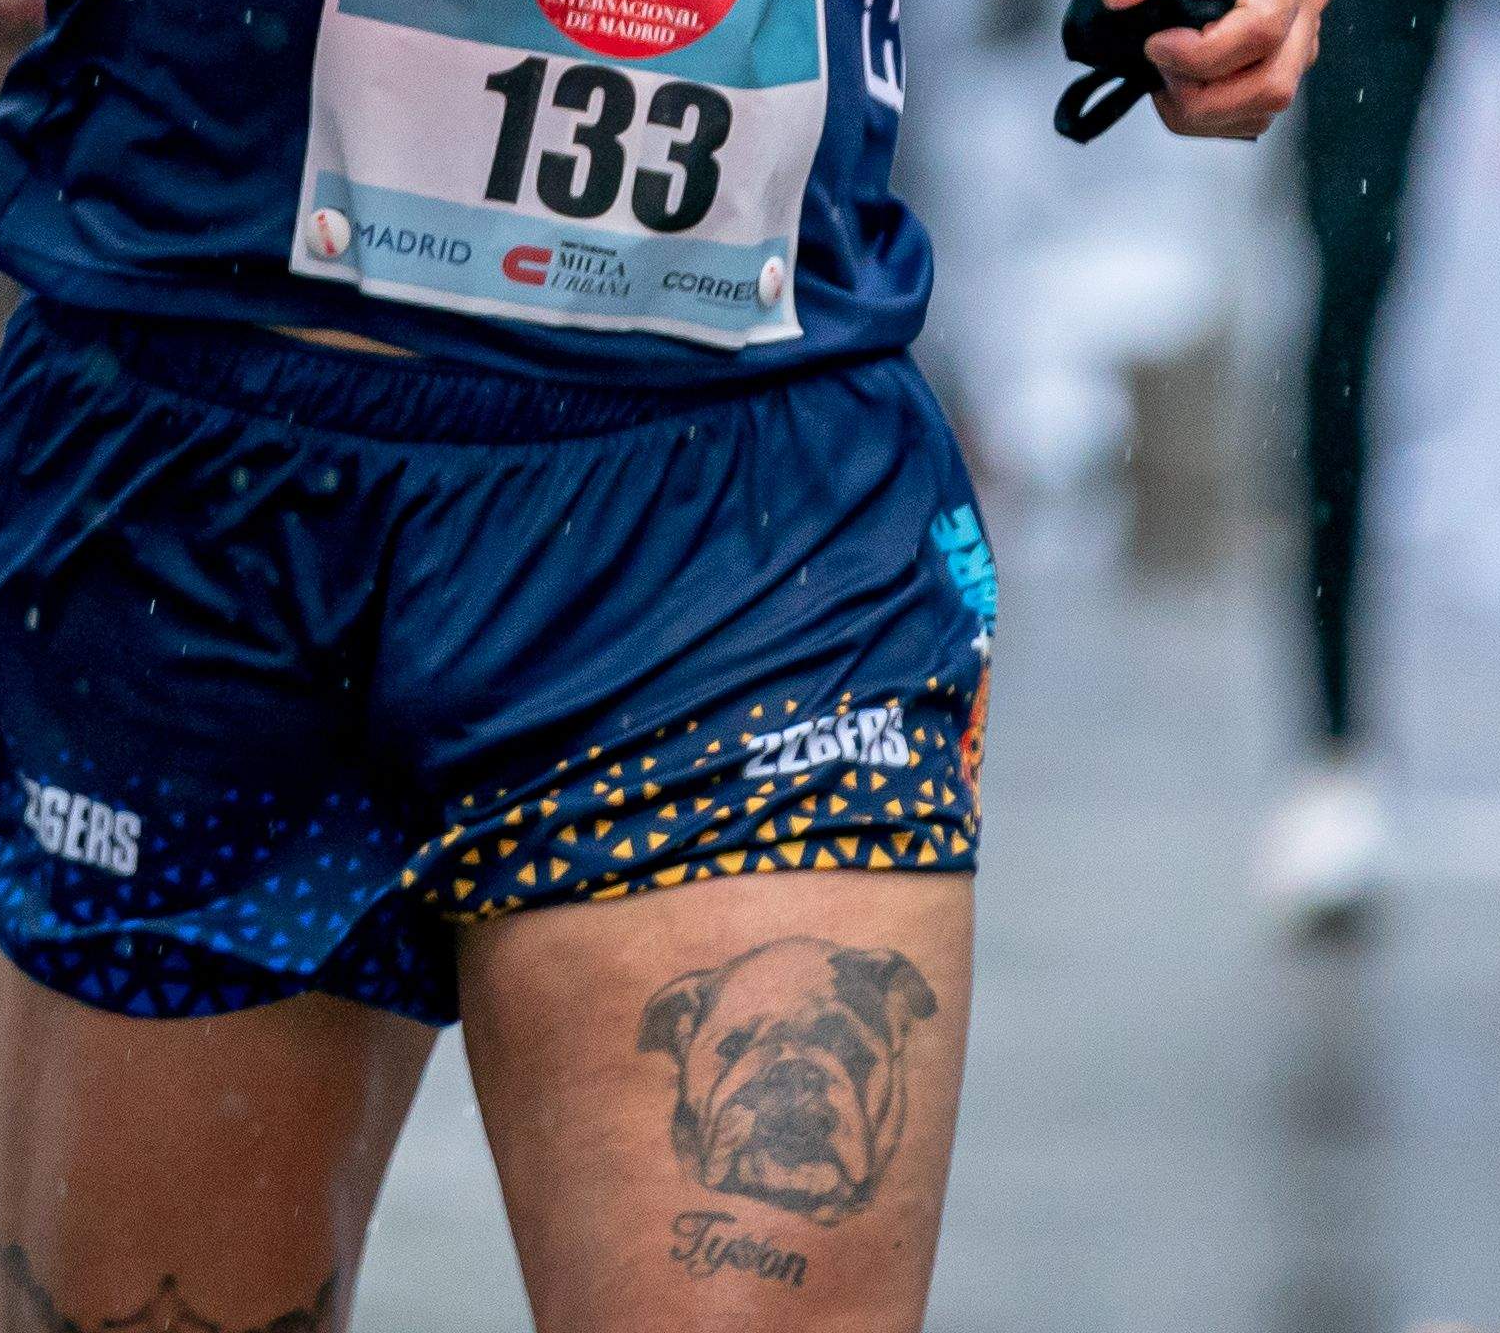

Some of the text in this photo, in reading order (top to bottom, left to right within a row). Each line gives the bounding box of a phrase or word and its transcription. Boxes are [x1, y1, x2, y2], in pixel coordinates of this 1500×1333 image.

[565, 9, 677, 43] DE MADRID
[484, 55, 733, 234] 133
[353, 221, 472, 266] MADRID
[743, 706, 910, 780] 226ERS
